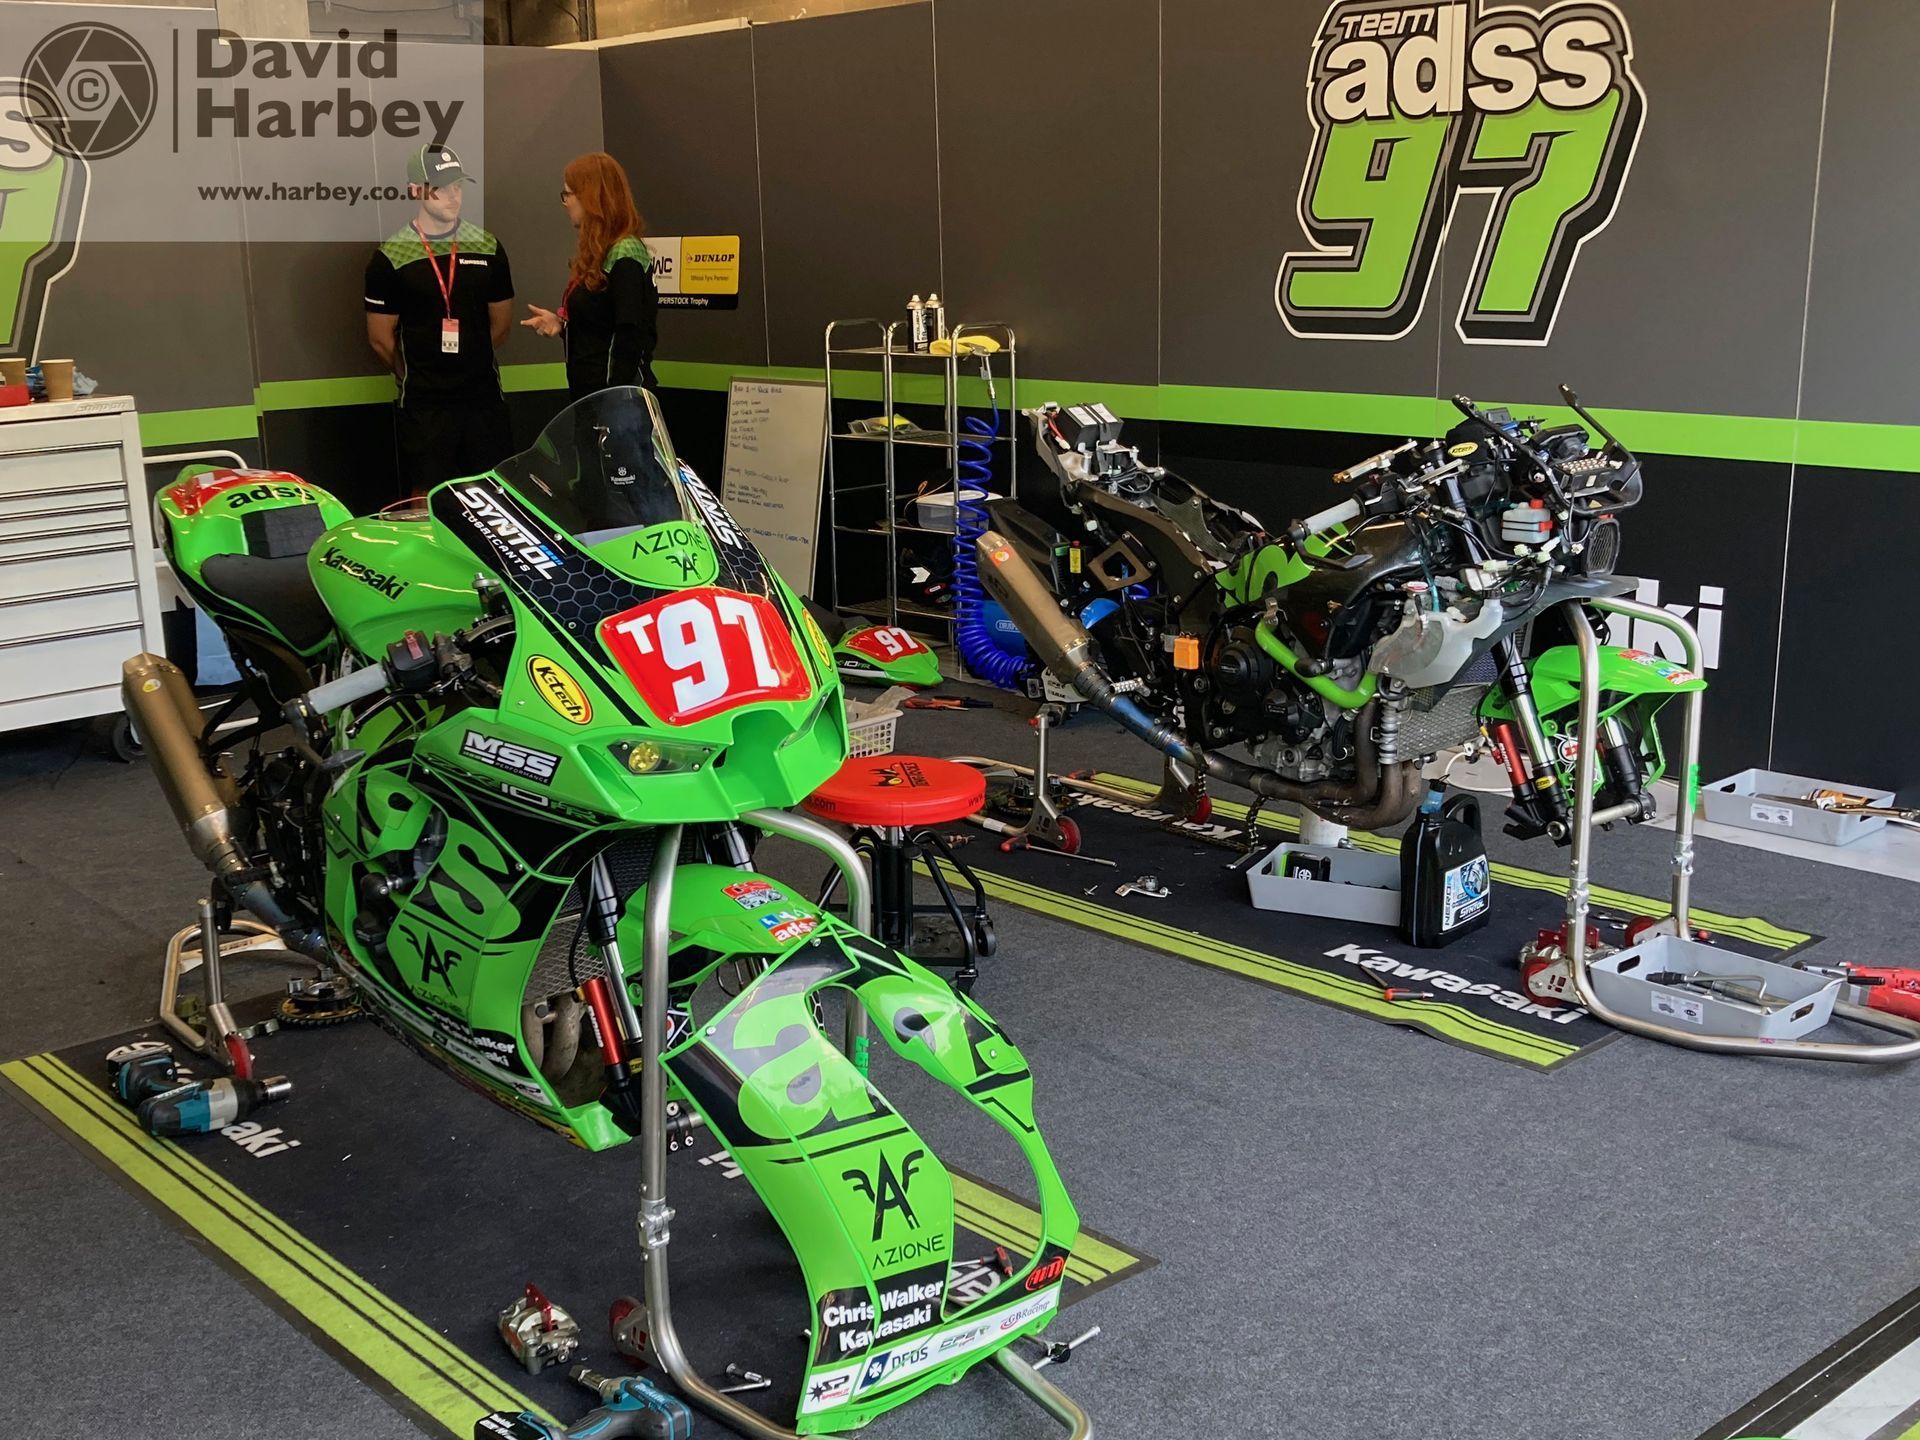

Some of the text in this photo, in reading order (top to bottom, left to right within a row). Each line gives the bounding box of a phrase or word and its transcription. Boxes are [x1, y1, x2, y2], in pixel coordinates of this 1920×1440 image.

[1323, 4, 1616, 120] adss
[1289, 88, 1620, 312] 97
[694, 254, 735, 262] DUNLOP
[227, 485, 316, 508] adss
[457, 487, 552, 580] SYNTOL
[461, 511, 531, 572] LUBRICANTS
[319, 546, 409, 600] Kawasaki
[874, 628, 918, 656] 97
[536, 664, 583, 720] K-tech
[464, 732, 557, 778] MSS
[495, 762, 549, 784] PERFORMANCE
[1323, 943, 1589, 1025] Kawasaki
[872, 1234, 945, 1270] AZIONE
[823, 1303, 875, 1328] Chris
[880, 1281, 943, 1312] Walker
[839, 1305, 932, 1352] Kawasaki
[892, 1347, 928, 1370] DFDS
